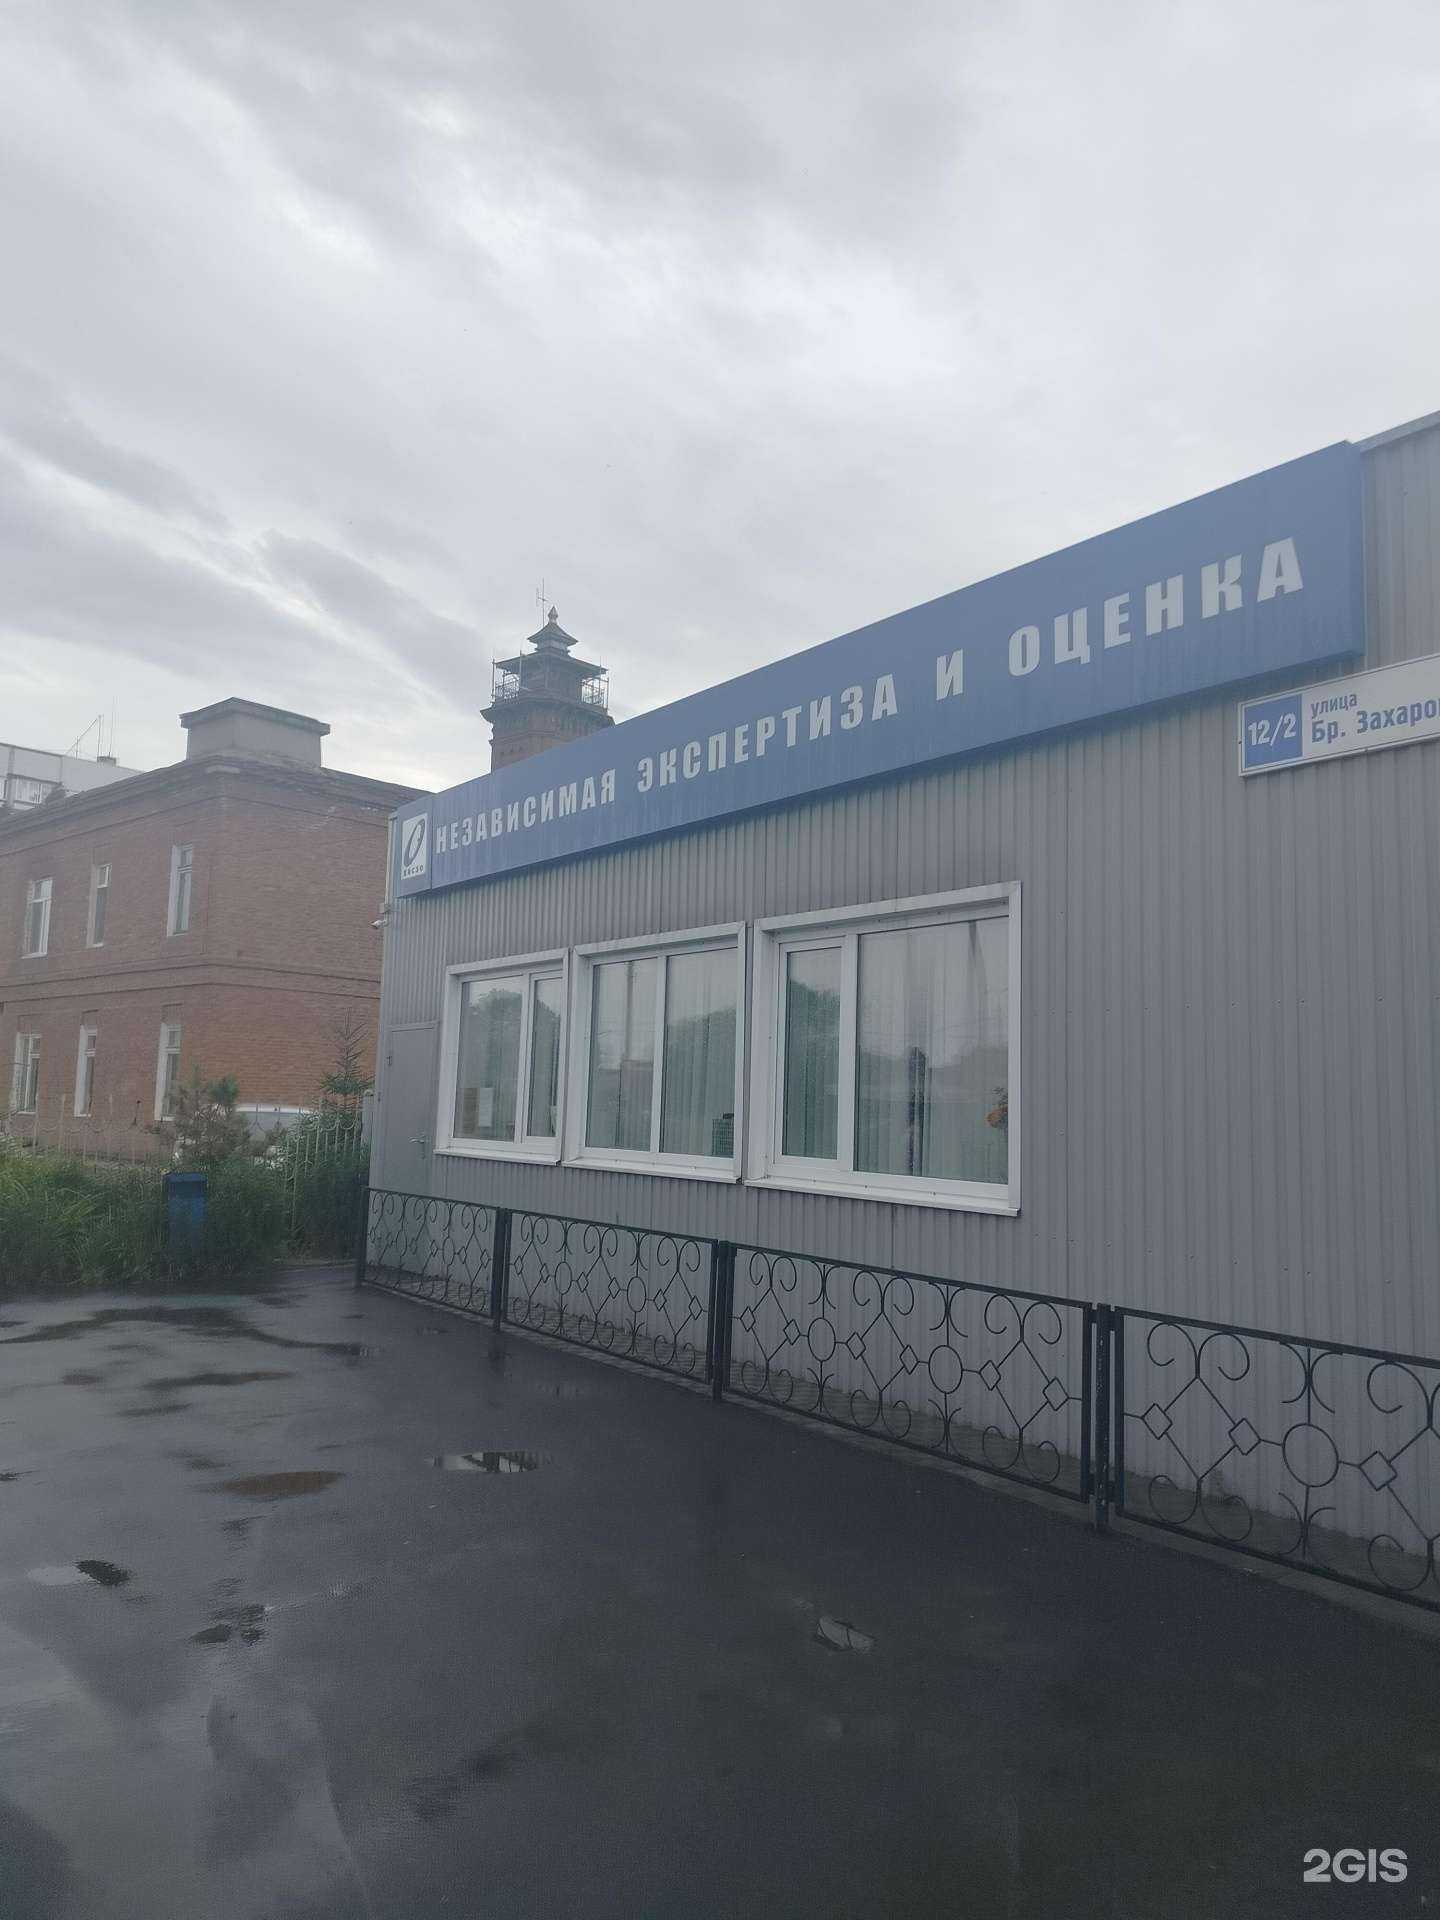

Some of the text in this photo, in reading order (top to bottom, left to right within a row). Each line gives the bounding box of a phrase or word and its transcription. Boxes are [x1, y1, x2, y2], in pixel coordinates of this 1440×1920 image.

[435, 536, 1303, 854] НЕЗАВИСИМАЯ ЭКСПЕРТИЗА И ОЦЕНКА
[1310, 693, 1358, 719] улица
[1247, 713, 1297, 747] 12/2
[1311, 698, 1440, 744] Бр. Захаро
